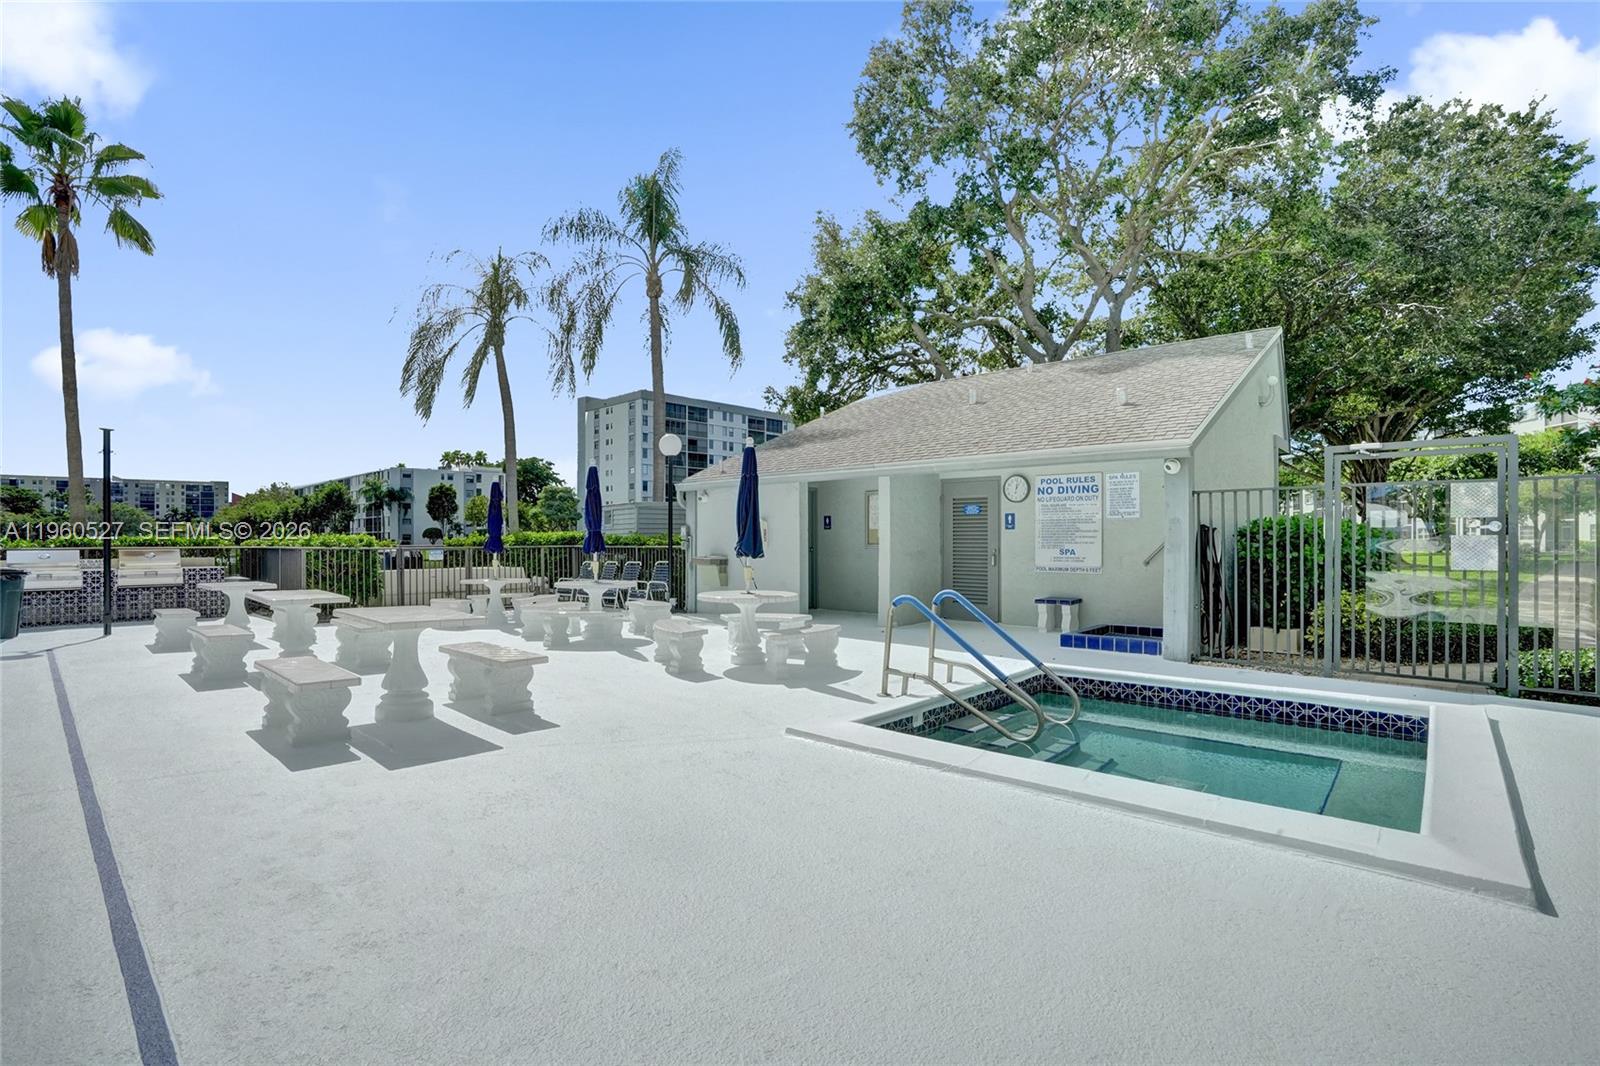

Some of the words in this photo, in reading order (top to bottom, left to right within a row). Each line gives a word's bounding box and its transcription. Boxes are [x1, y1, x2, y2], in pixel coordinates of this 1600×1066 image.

[1066, 475, 1095, 483] RULES
[1037, 486, 1054, 495] NO
[1057, 485, 1099, 494] DIVING
